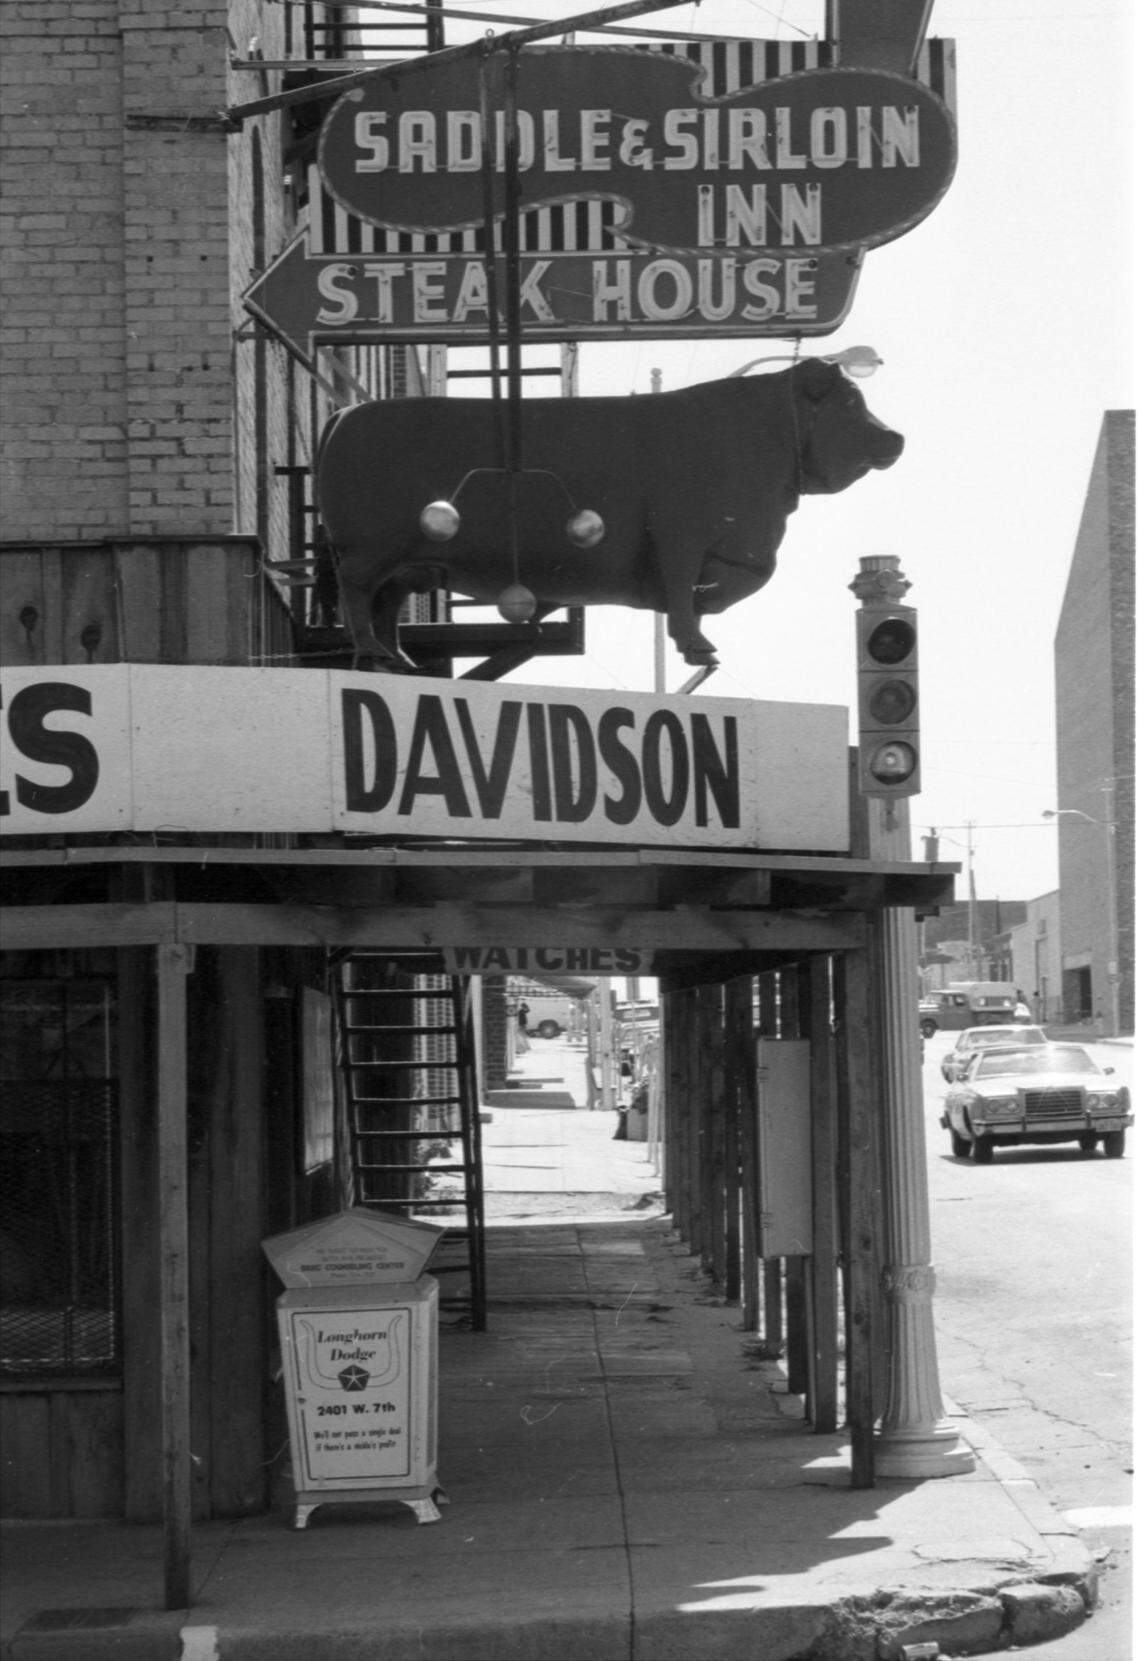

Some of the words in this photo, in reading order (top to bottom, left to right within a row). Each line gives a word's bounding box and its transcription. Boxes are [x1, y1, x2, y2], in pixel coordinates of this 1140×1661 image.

[355, 109, 612, 173] SADDLE
[620, 119, 653, 170] &
[664, 105, 920, 170] SIRLOIN
[698, 183, 822, 246] INN
[317, 260, 555, 326] STEAK
[592, 257, 818, 322] HOUSE
[0, 681, 99, 817] S
[341, 688, 740, 829] DAVIDSON
[454, 949, 641, 972] WATCHES
[317, 1329, 387, 1345] Longhorn
[330, 1347, 376, 1362] Dodge
[317, 1404, 347, 1416] 2401
[352, 1403, 369, 1414] W.
[372, 1401, 396, 1413] 7th
